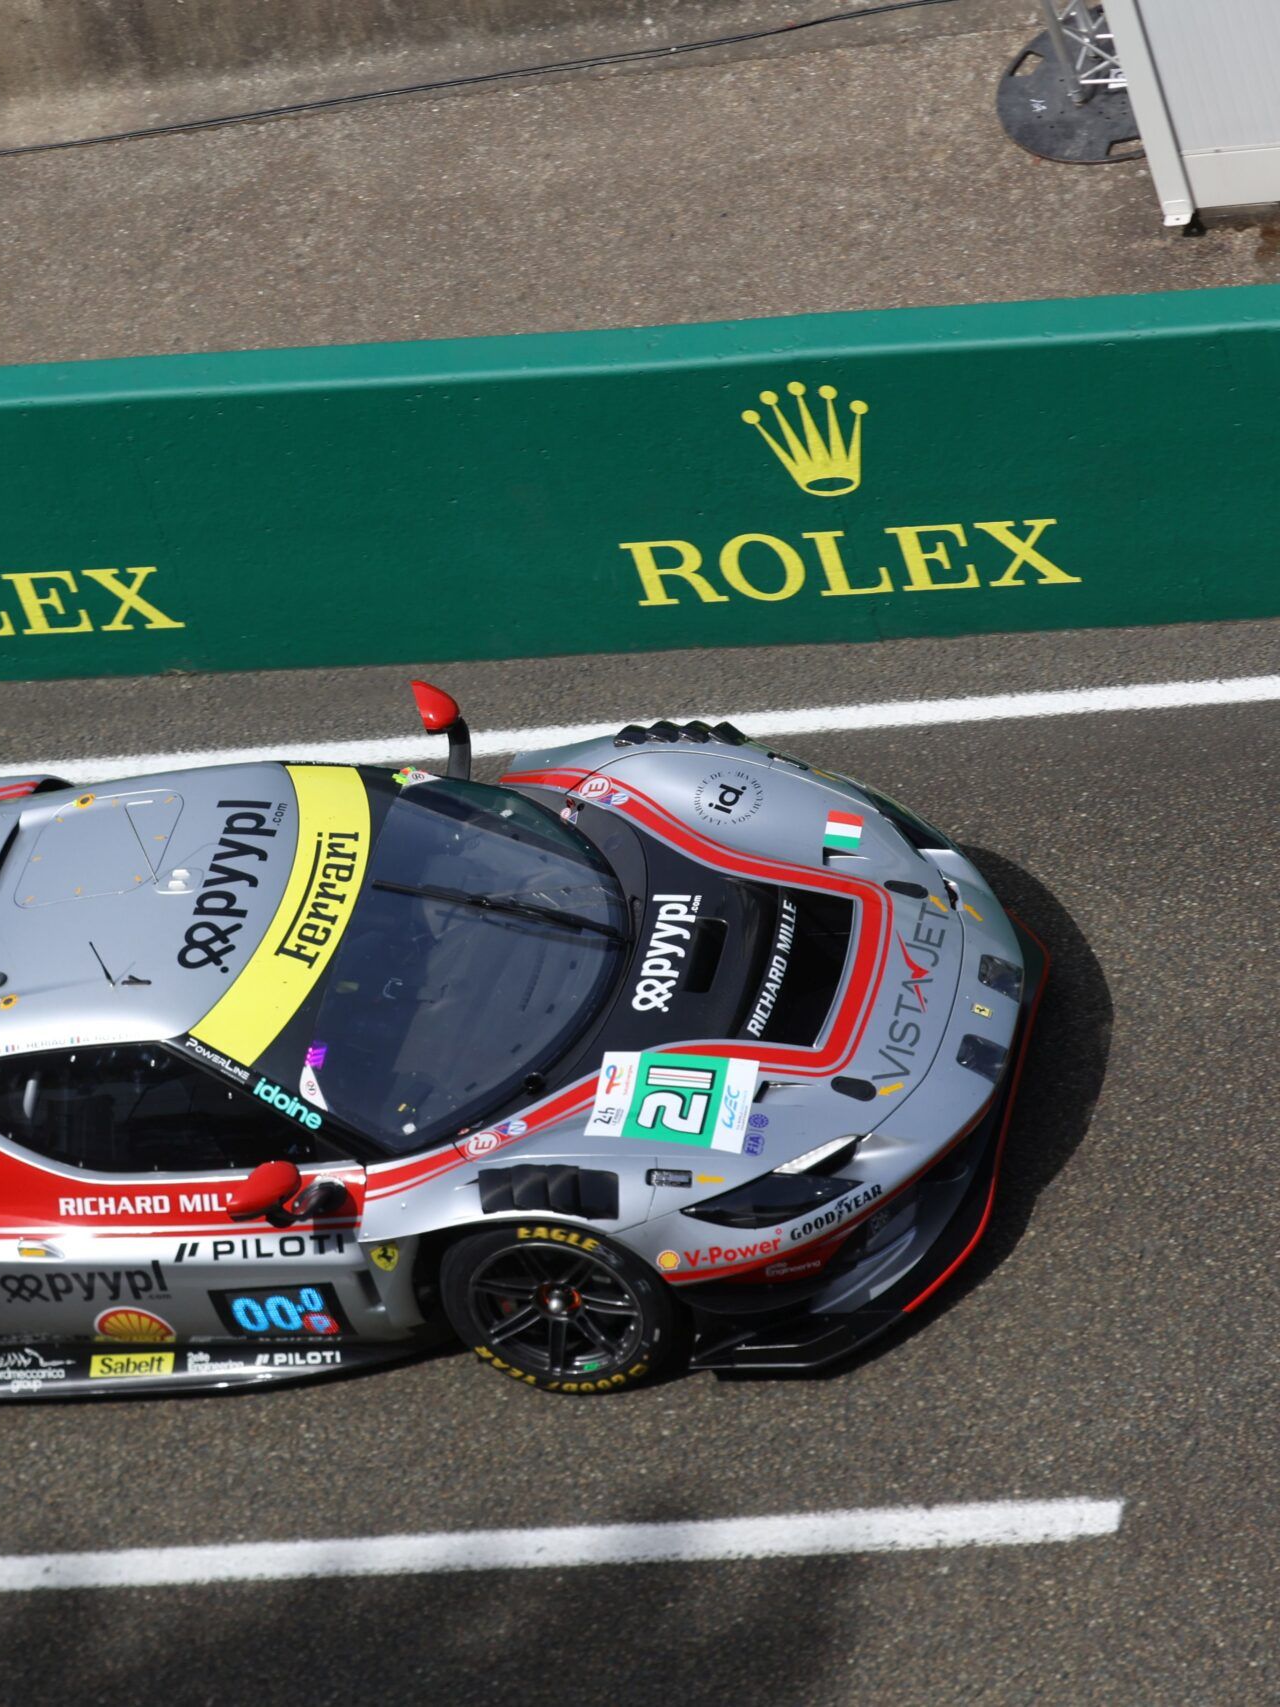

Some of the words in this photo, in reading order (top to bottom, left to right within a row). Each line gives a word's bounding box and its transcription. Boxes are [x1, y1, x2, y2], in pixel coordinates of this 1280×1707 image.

[619, 518, 1083, 607] ROLEX
[708, 783, 747, 814] id.
[274, 831, 360, 969] Ferrari
[746, 955, 789, 1038] RICHARD
[776, 899, 798, 954] MILLE
[253, 1077, 323, 1130] idoine
[635, 1064, 717, 1136] 21
[721, 1084, 741, 1129] WEC
[58, 1195, 171, 1217] RICHARD
[179, 1192, 234, 1214] MIL
[789, 1183, 883, 1242] GOODYEAR
[212, 1232, 346, 1262] PILOTI
[516, 1226, 601, 1252] EAGLE
[684, 1236, 782, 1268] V-Power
[99, 1355, 165, 1376] Sabelt
[273, 1350, 342, 1367] PILOTI
